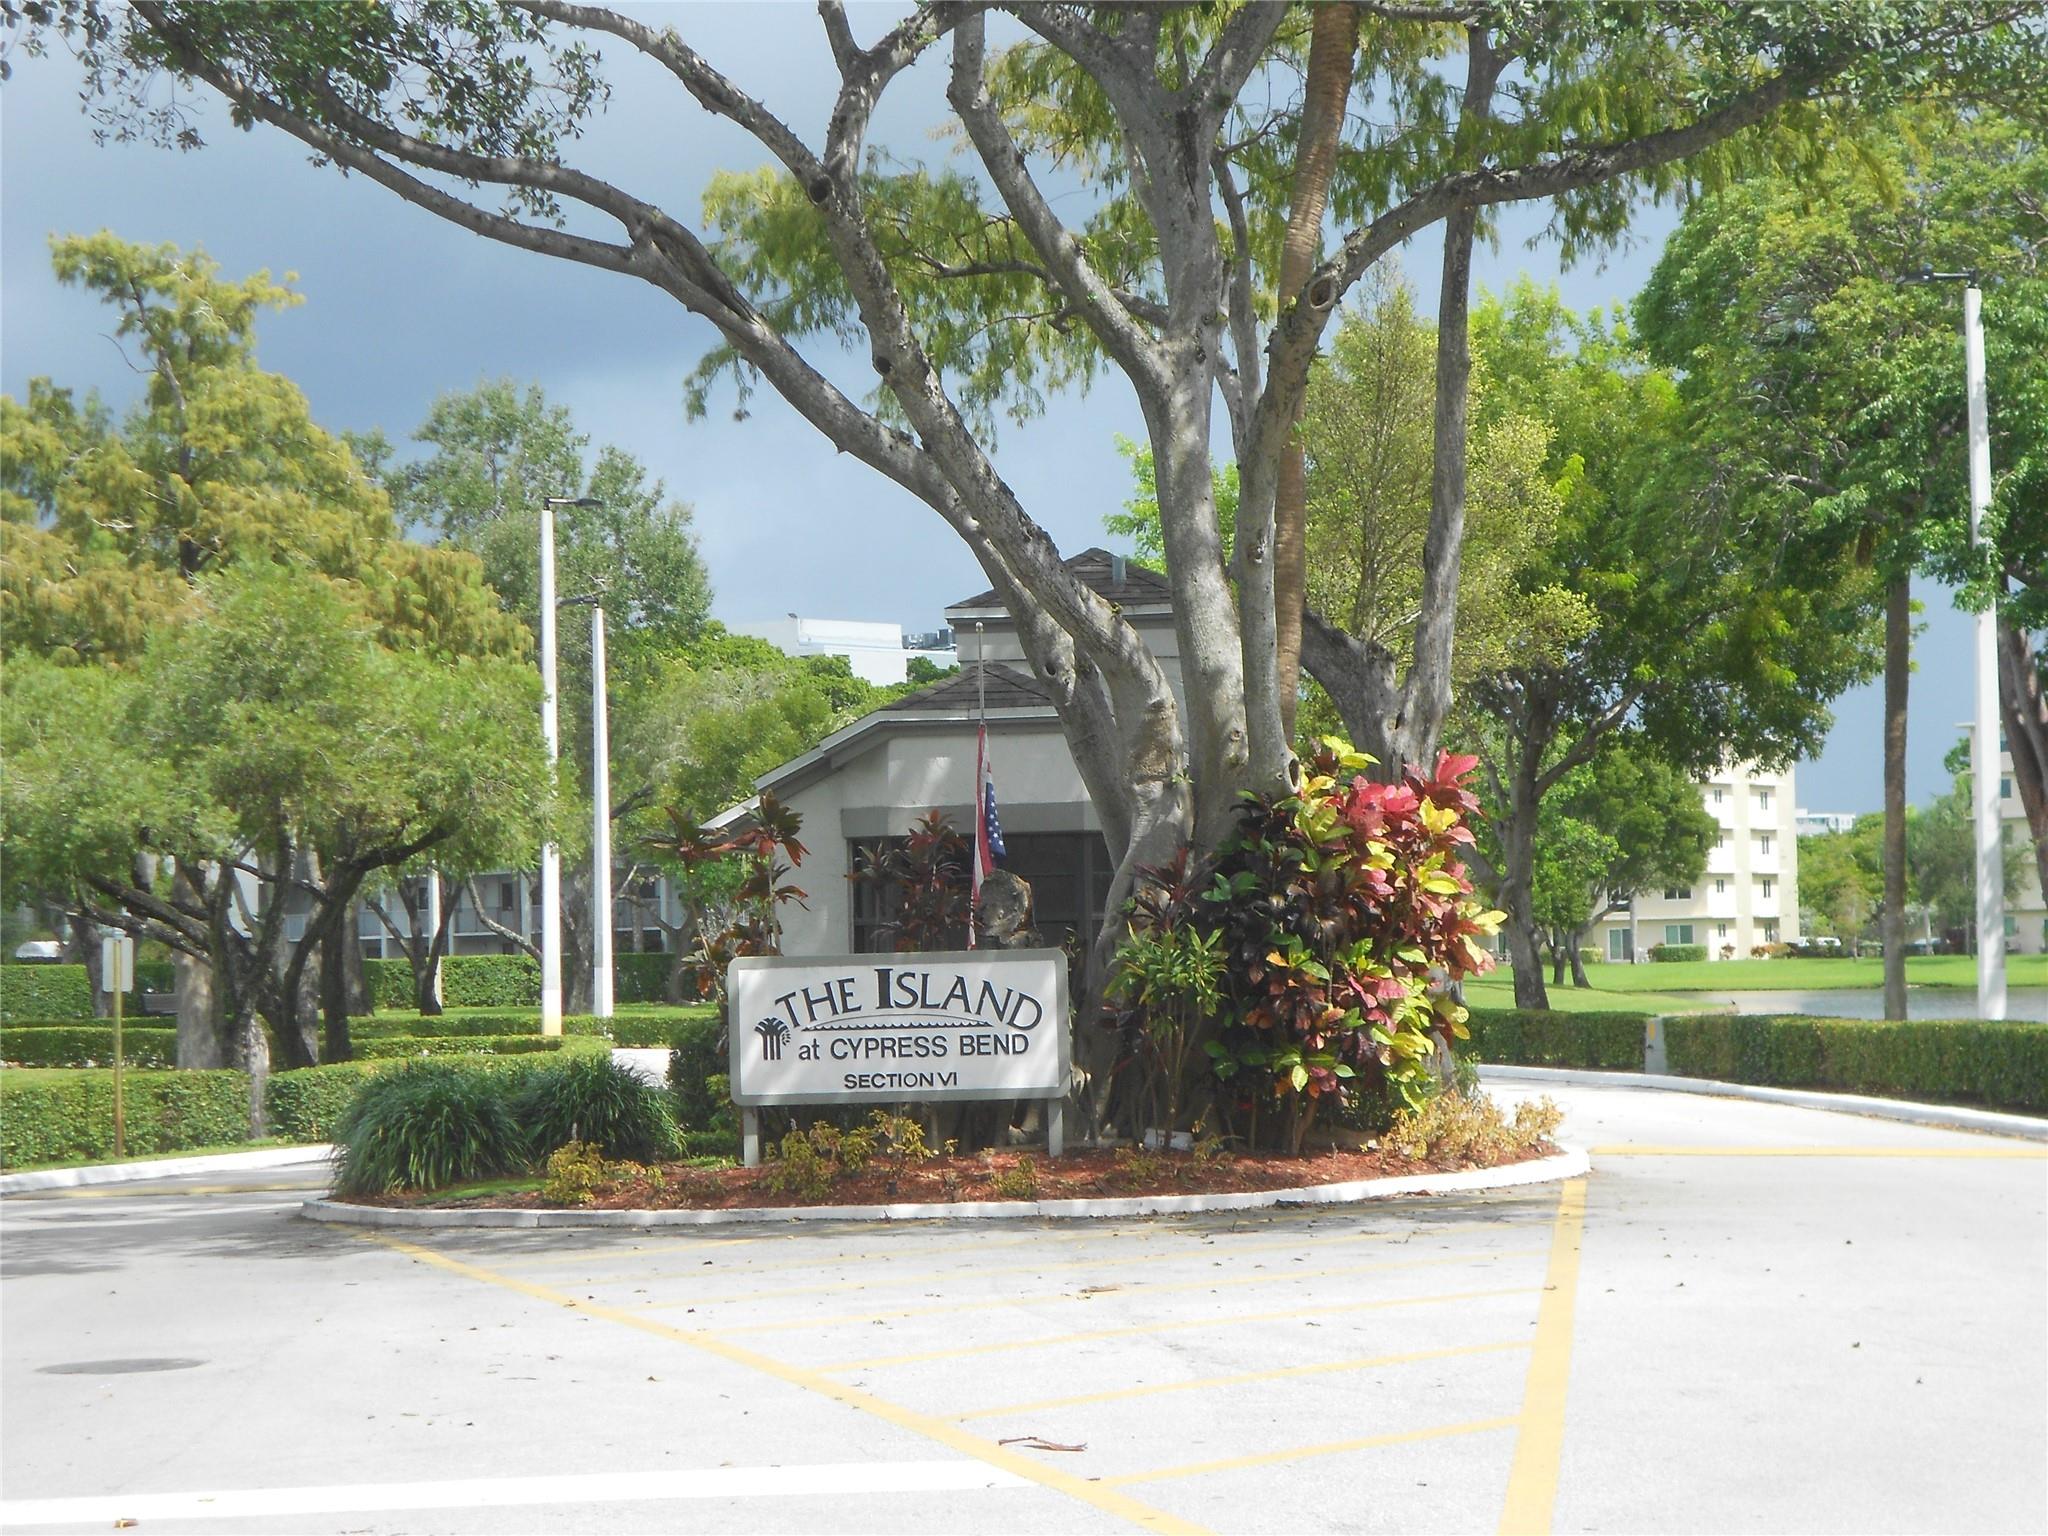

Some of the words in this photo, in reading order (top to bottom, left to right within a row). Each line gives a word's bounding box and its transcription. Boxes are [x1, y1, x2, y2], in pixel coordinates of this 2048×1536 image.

[774, 977, 862, 1028] THE
[873, 968, 1043, 1030] ISLAND
[798, 1040, 820, 1060] at
[829, 1035, 948, 1059] CYPRESS
[959, 1033, 1029, 1057] BEND
[844, 1072, 934, 1089] SECTION
[937, 1072, 958, 1086] VI
